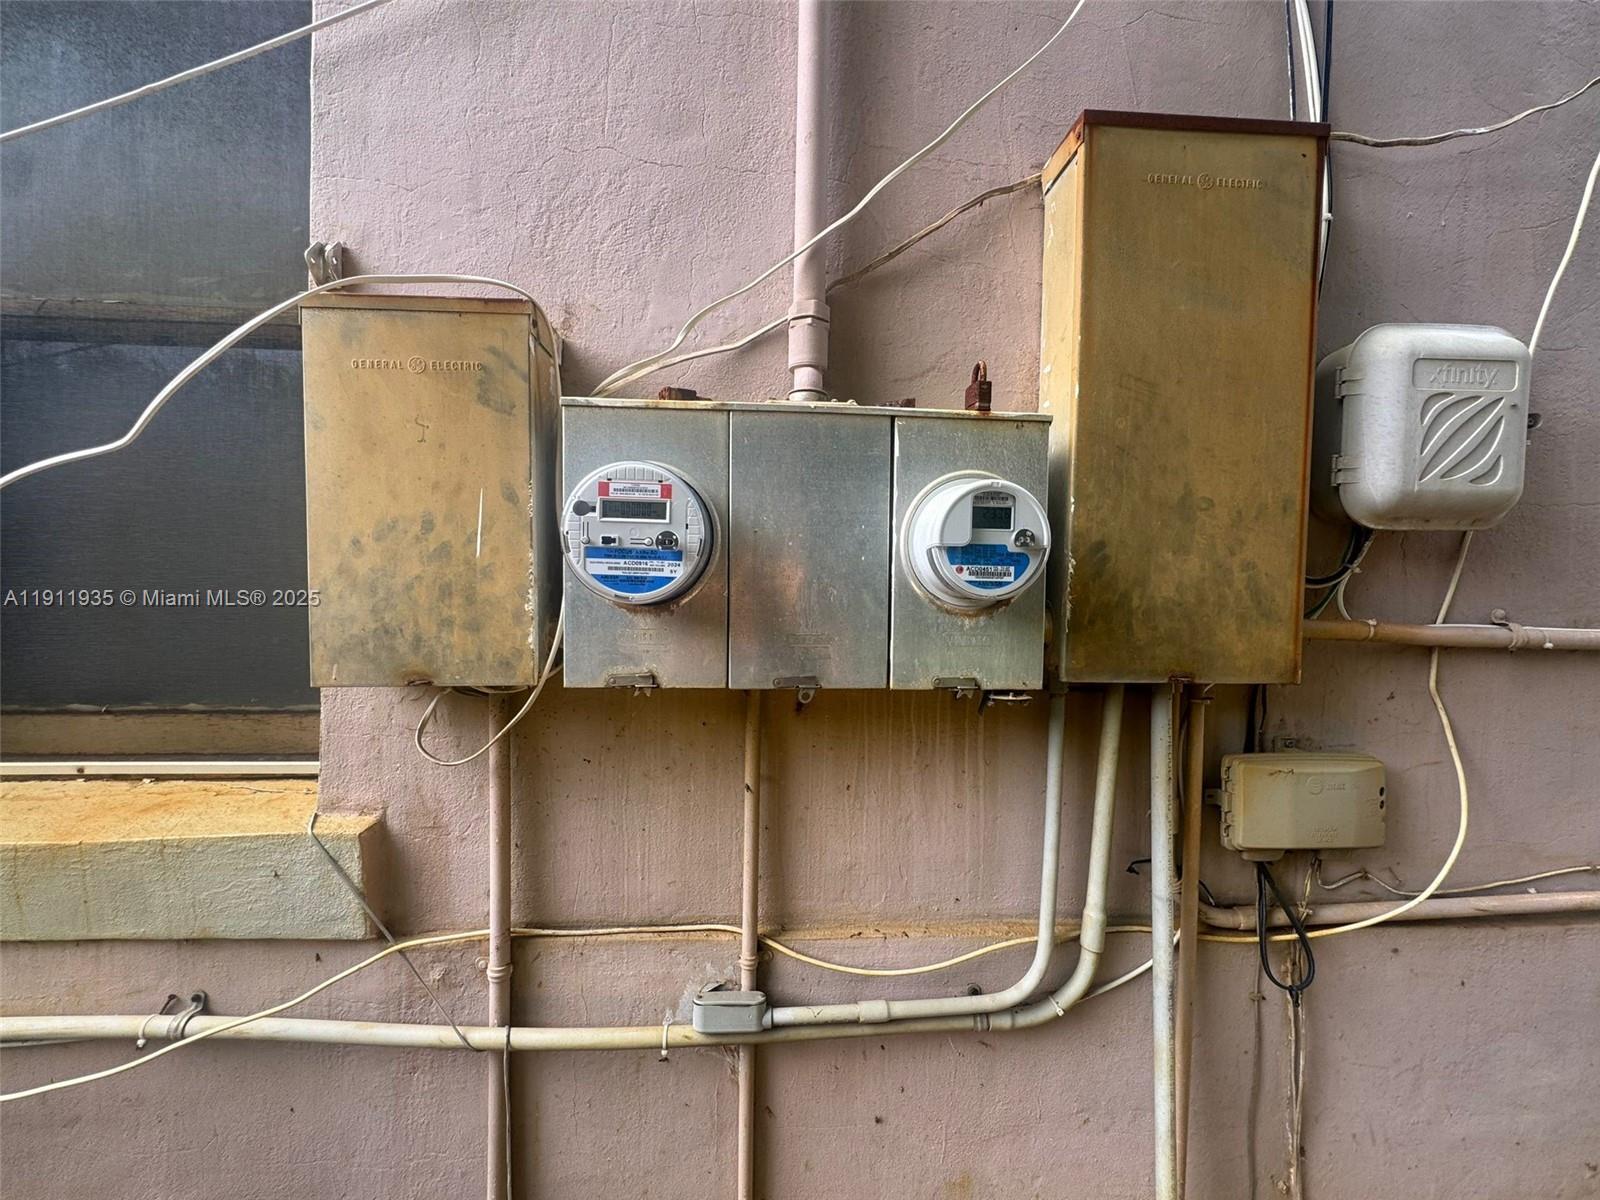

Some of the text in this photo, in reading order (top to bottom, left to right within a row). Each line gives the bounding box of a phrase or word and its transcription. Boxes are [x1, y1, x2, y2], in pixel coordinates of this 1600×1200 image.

[1147, 173, 1194, 186] GENERAL
[1217, 177, 1264, 190] ELECTRIC
[351, 359, 404, 370] GENERAL
[430, 360, 483, 371] ELECTRIC
